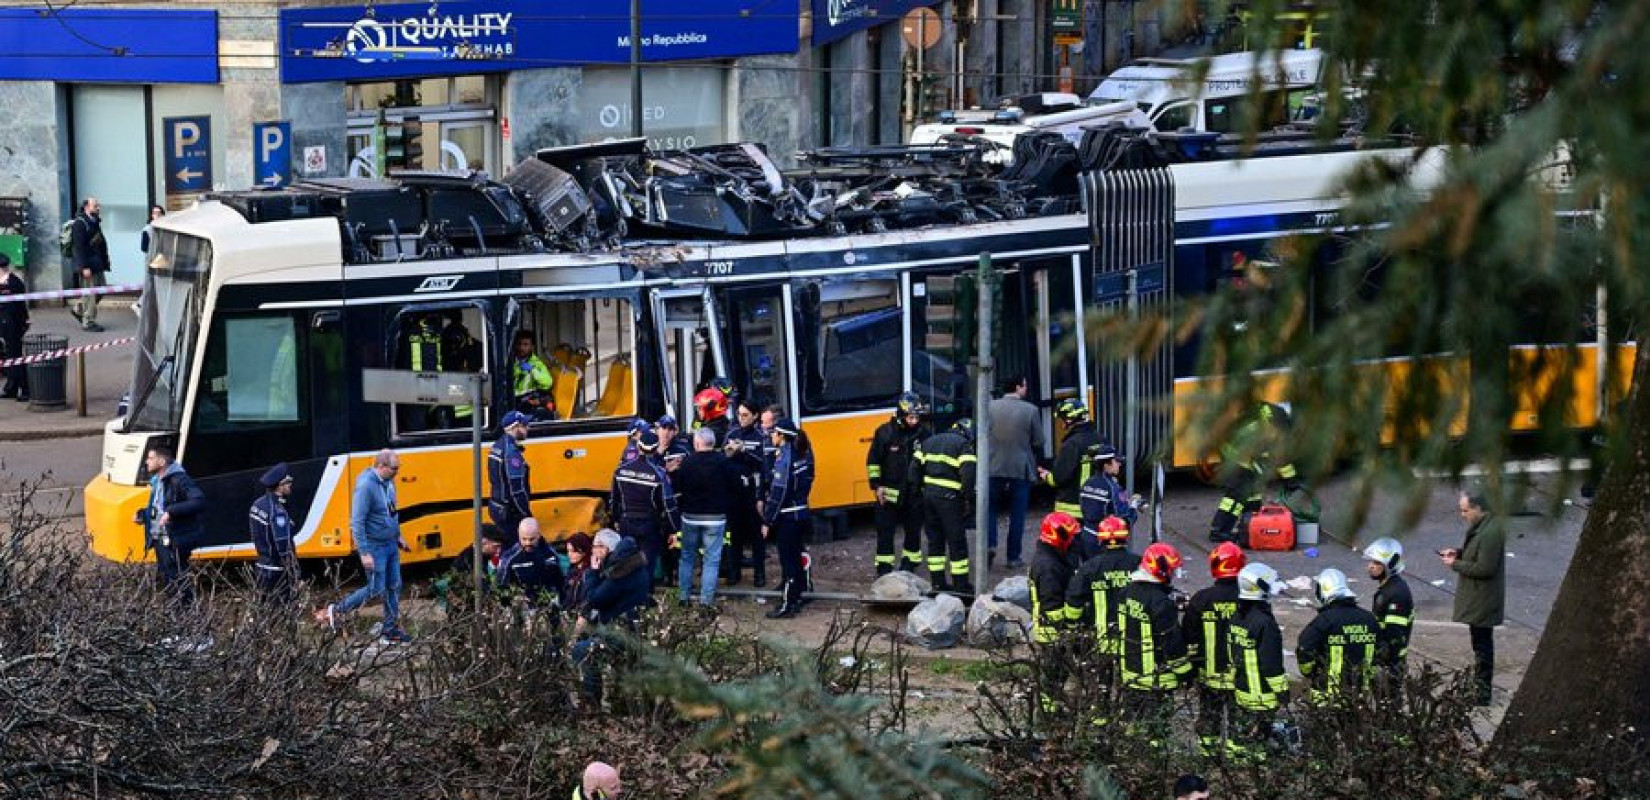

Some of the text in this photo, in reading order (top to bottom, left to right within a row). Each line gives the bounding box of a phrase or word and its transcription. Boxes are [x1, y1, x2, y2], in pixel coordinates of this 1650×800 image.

[401, 12, 513, 44] QUALITY
[617, 31, 707, 47] Mino Repubblica
[174, 122, 200, 158] P
[262, 126, 283, 162] P
[703, 260, 734, 275] 7707
[1328, 634, 1348, 645] DEL
